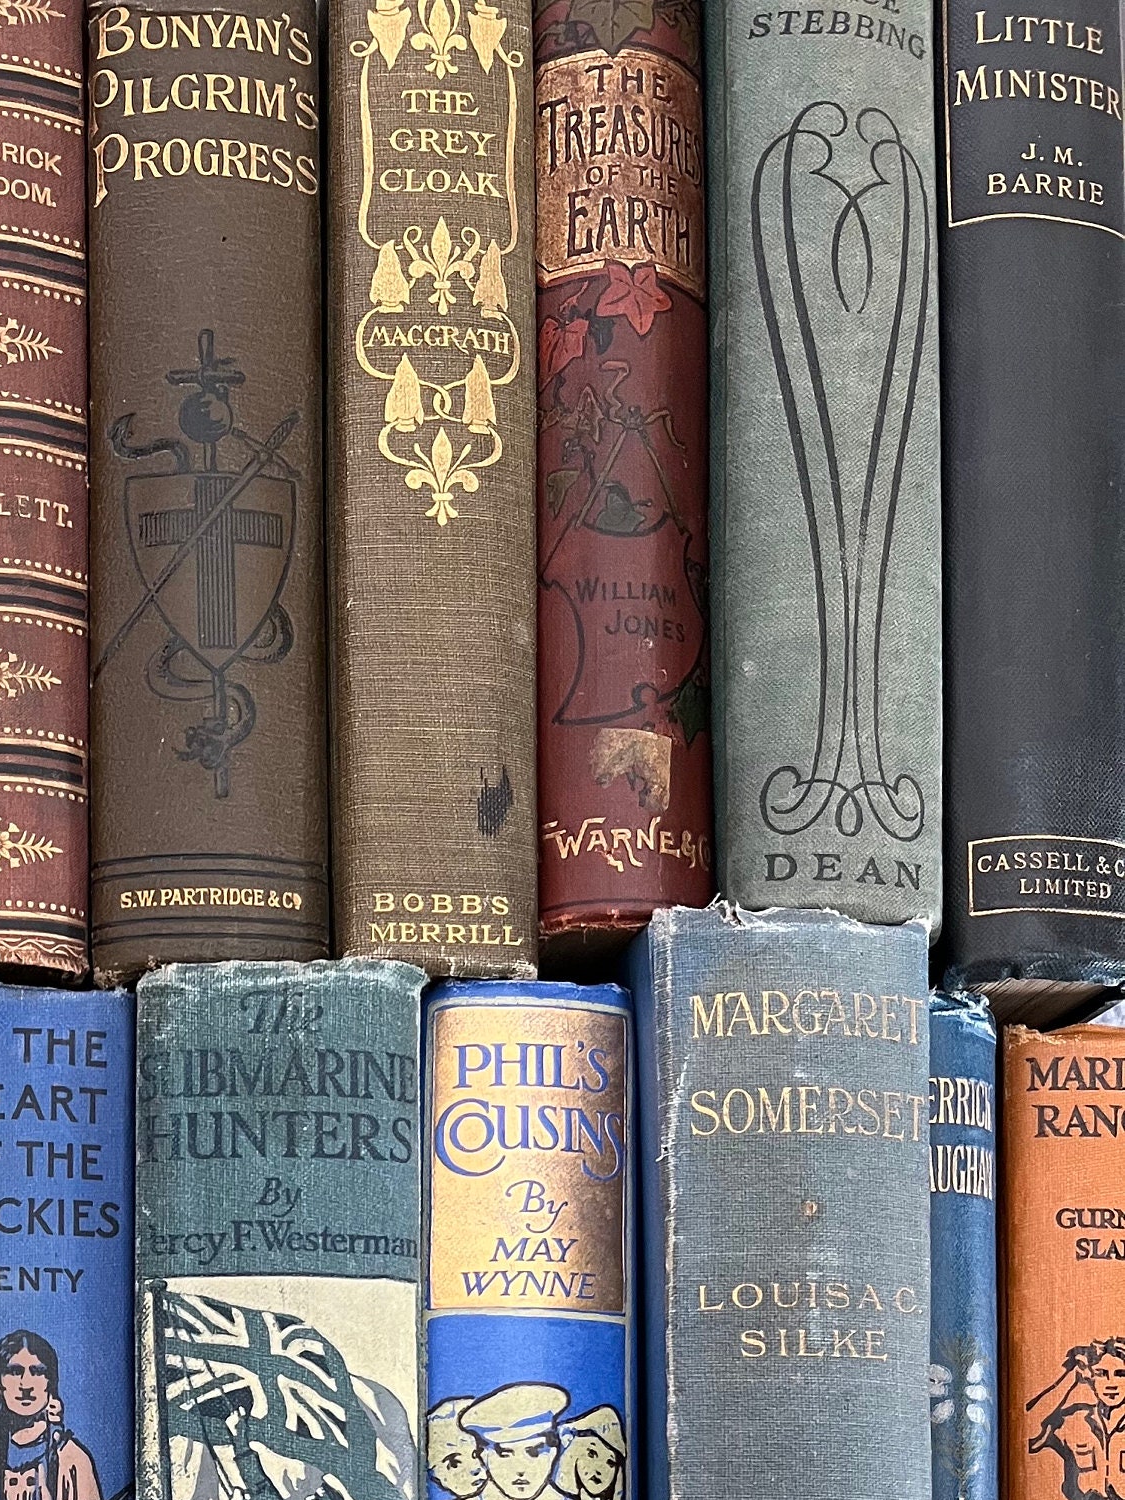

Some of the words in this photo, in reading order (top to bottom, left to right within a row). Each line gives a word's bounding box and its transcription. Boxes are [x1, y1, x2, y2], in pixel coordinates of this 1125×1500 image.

[96, 7, 312, 66] BUNYAN'S
[747, 10, 927, 60] STEBBING
[975, 11, 1105, 55] LITTLE
[401, 89, 479, 116] THE
[584, 63, 672, 103] THE
[953, 64, 1124, 120] MINISTER
[90, 69, 318, 138] PILGRIM'S
[389, 128, 496, 158] GREY
[539, 96, 703, 182] TREASURES
[1021, 146, 1046, 161] J.
[1053, 145, 1084, 167] M.
[93, 133, 318, 208] PROGRESS
[379, 169, 504, 199] CLOAK
[586, 165, 619, 187] OF
[638, 164, 678, 197] THE
[986, 172, 1106, 206] BARRIE
[567, 188, 692, 268] EARTH
[364, 324, 511, 355] MACGRATH
[576, 577, 675, 608] WILLIAM
[605, 609, 686, 643] JONES
[765, 853, 922, 891] DEAN
[977, 851, 1090, 873] CASSELL
[1096, 856, 1112, 875] &
[161, 887, 264, 907] PARTRIDGE
[267, 890, 280, 908] &
[1019, 878, 1112, 900] LIMITED
[370, 922, 523, 946] MERRILL
[239, 990, 324, 1034] The
[692, 991, 922, 1046] MARGARET
[13, 1028, 107, 1068] THE
[453, 1042, 610, 1092] PHIL'S
[691, 1085, 925, 1142] SOMERSET
[141, 1111, 413, 1164] HUNTERS
[435, 1098, 625, 1181] COUSINS
[17, 1141, 104, 1180] THE
[257, 1177, 302, 1217] By
[506, 1180, 569, 1232] By
[489, 1237, 579, 1264] MAY
[462, 1271, 596, 1299] WYNNE
[699, 1284, 884, 1312] LOUISA
[740, 1330, 888, 1361] SILKE
